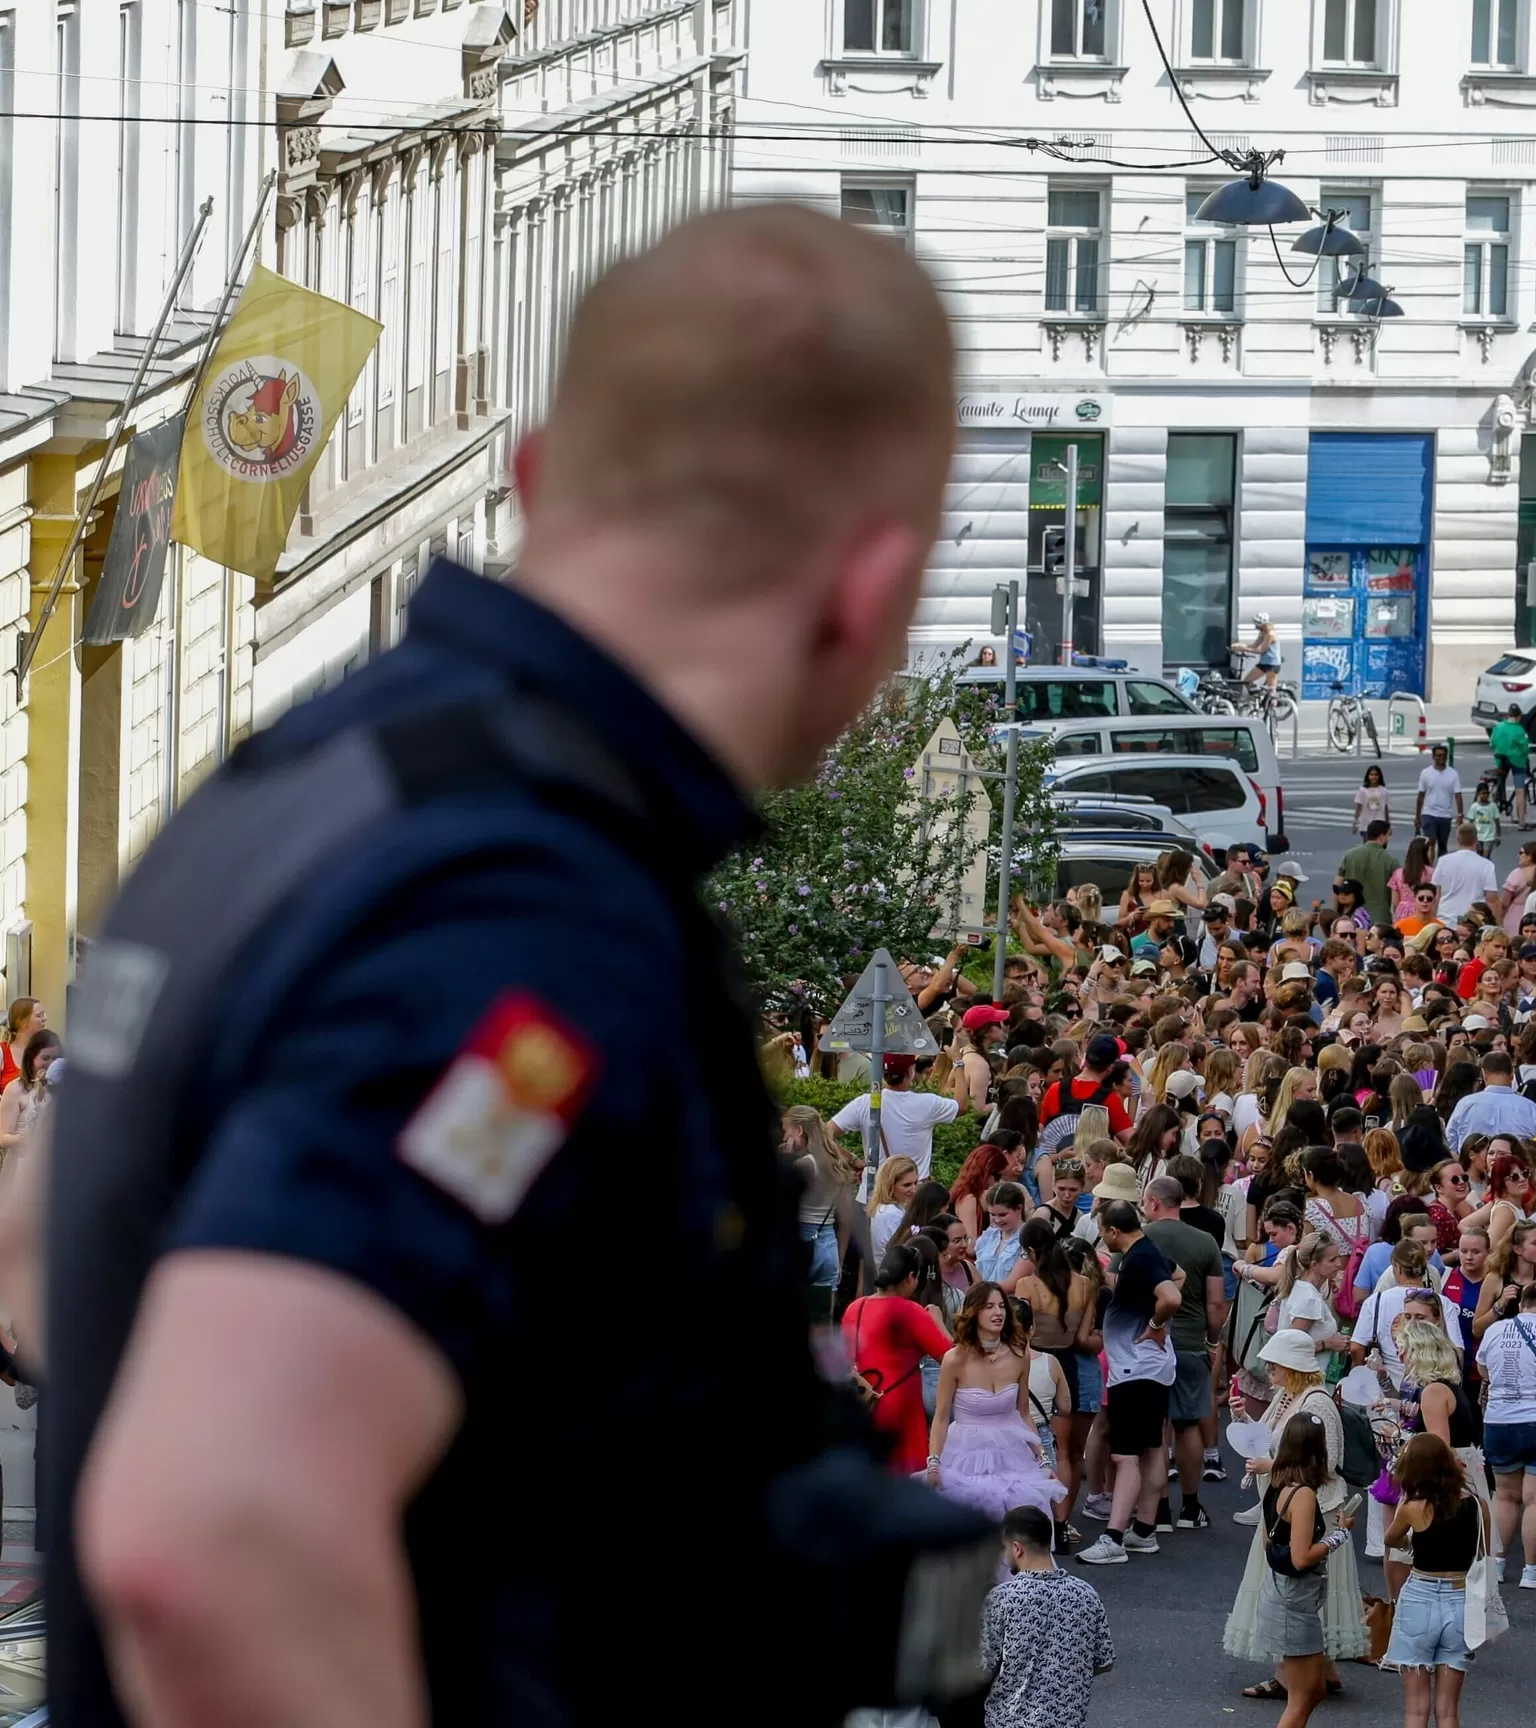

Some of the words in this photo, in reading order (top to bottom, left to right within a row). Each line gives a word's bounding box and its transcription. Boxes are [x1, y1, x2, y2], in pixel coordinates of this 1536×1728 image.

[207, 368, 251, 465] VOLKSSCHULE
[1005, 397, 1063, 424] Lounge
[1500, 1340, 1522, 1349] 2023
